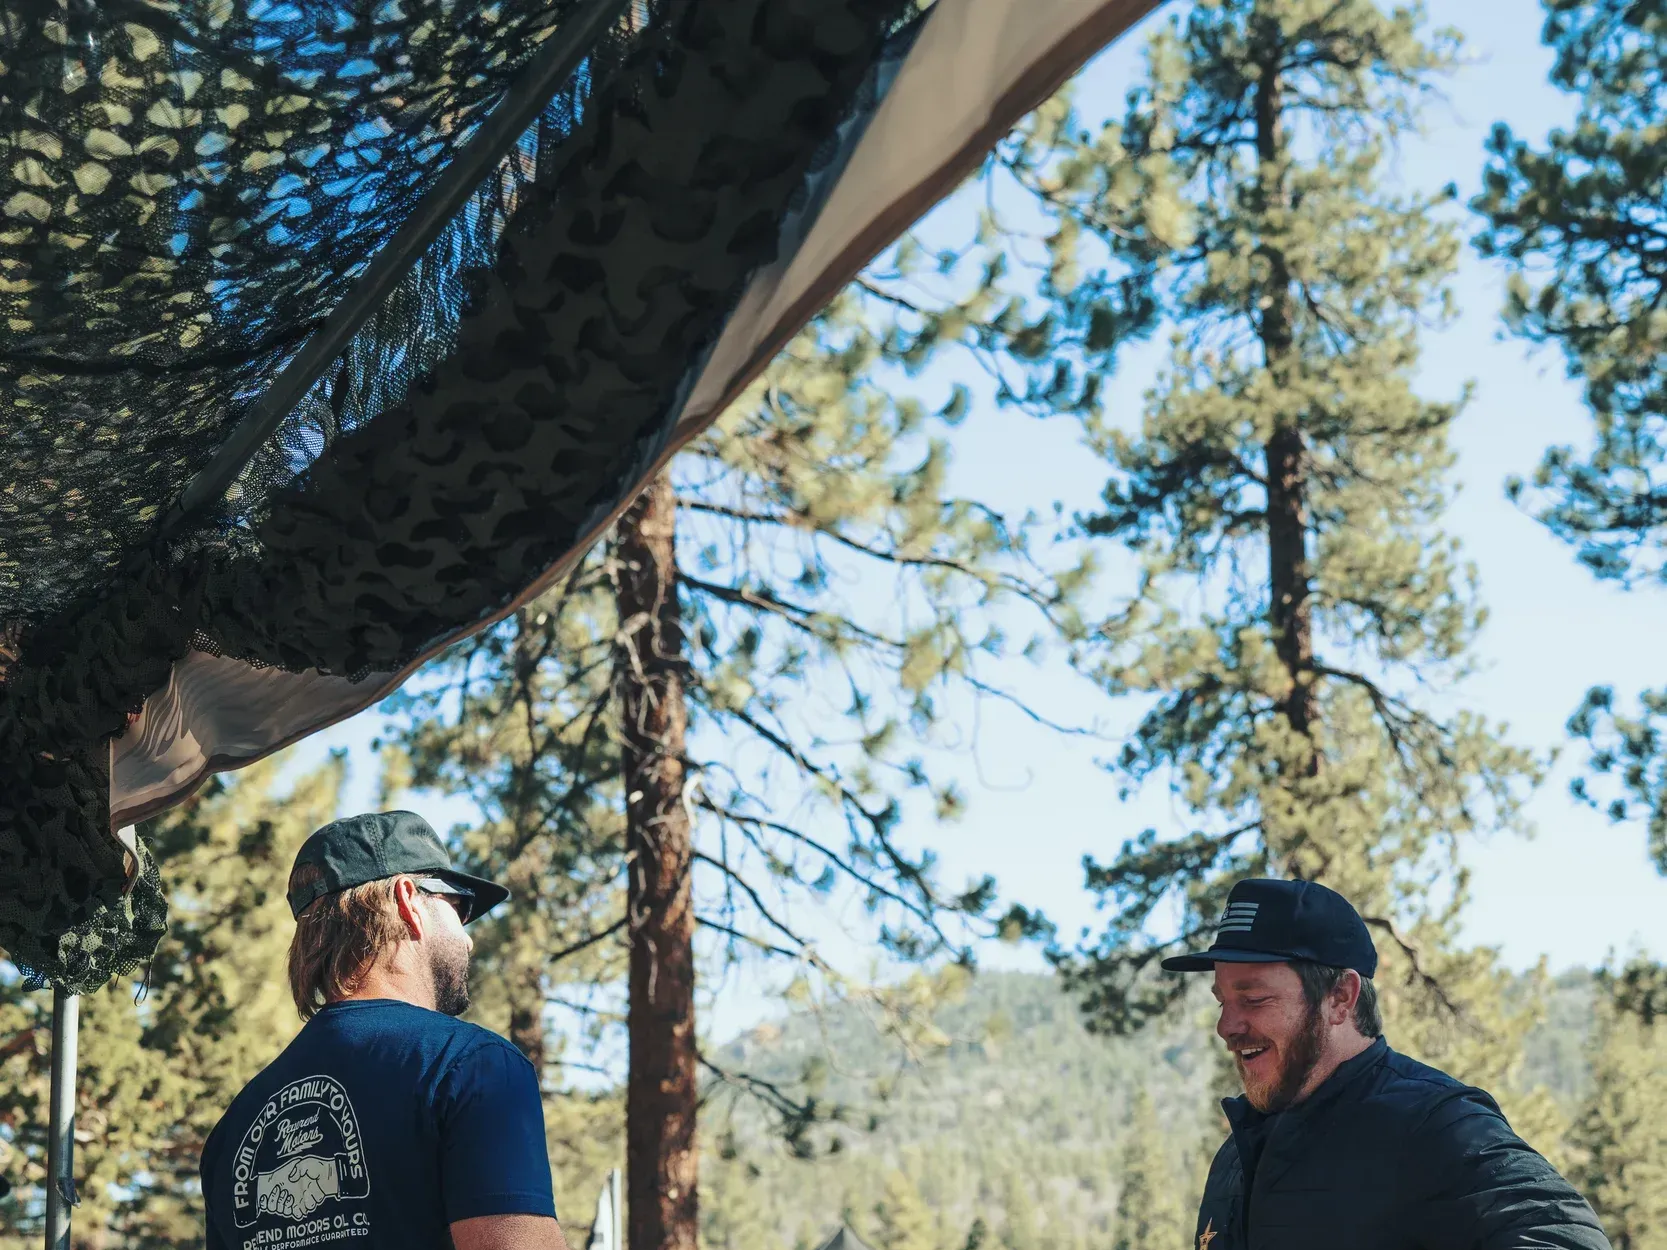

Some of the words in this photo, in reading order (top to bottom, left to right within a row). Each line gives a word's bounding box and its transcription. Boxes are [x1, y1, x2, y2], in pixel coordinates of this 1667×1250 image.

[234, 1146, 255, 1209] FROM
[250, 1101, 278, 1143] OUR
[280, 1080, 331, 1108] FAMILY
[328, 1083, 344, 1111] TO
[341, 1106, 364, 1179] YOURS
[276, 1126, 322, 1156] Motors
